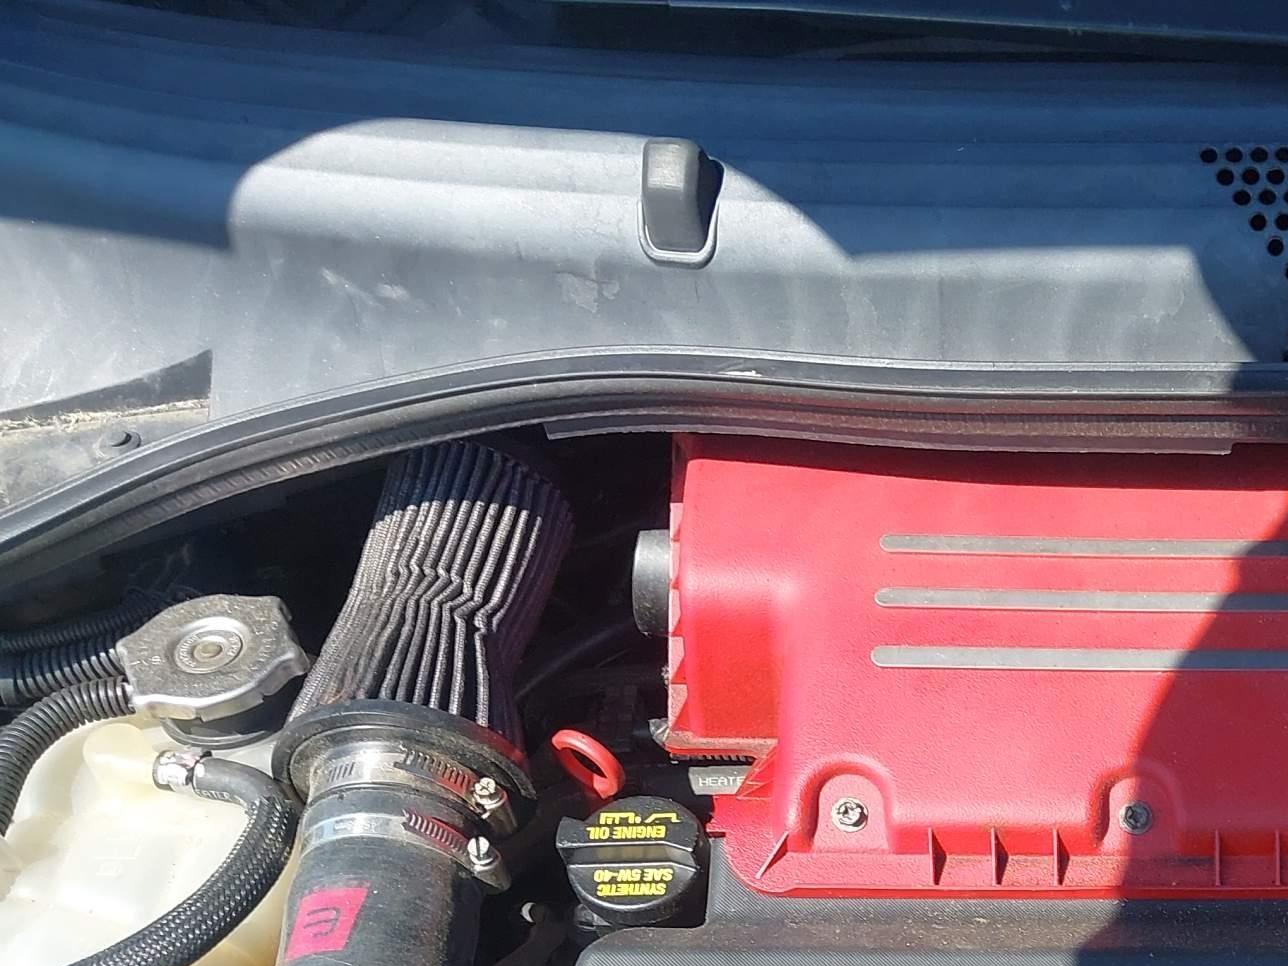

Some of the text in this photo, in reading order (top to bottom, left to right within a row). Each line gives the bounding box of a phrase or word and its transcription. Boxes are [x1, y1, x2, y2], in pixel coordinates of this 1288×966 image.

[698, 776, 746, 787] HEATE
[586, 825, 667, 840] ENGINE OIL
[593, 868, 674, 882] SAE 5W-40
[596, 883, 667, 897] SYNTHETIC
